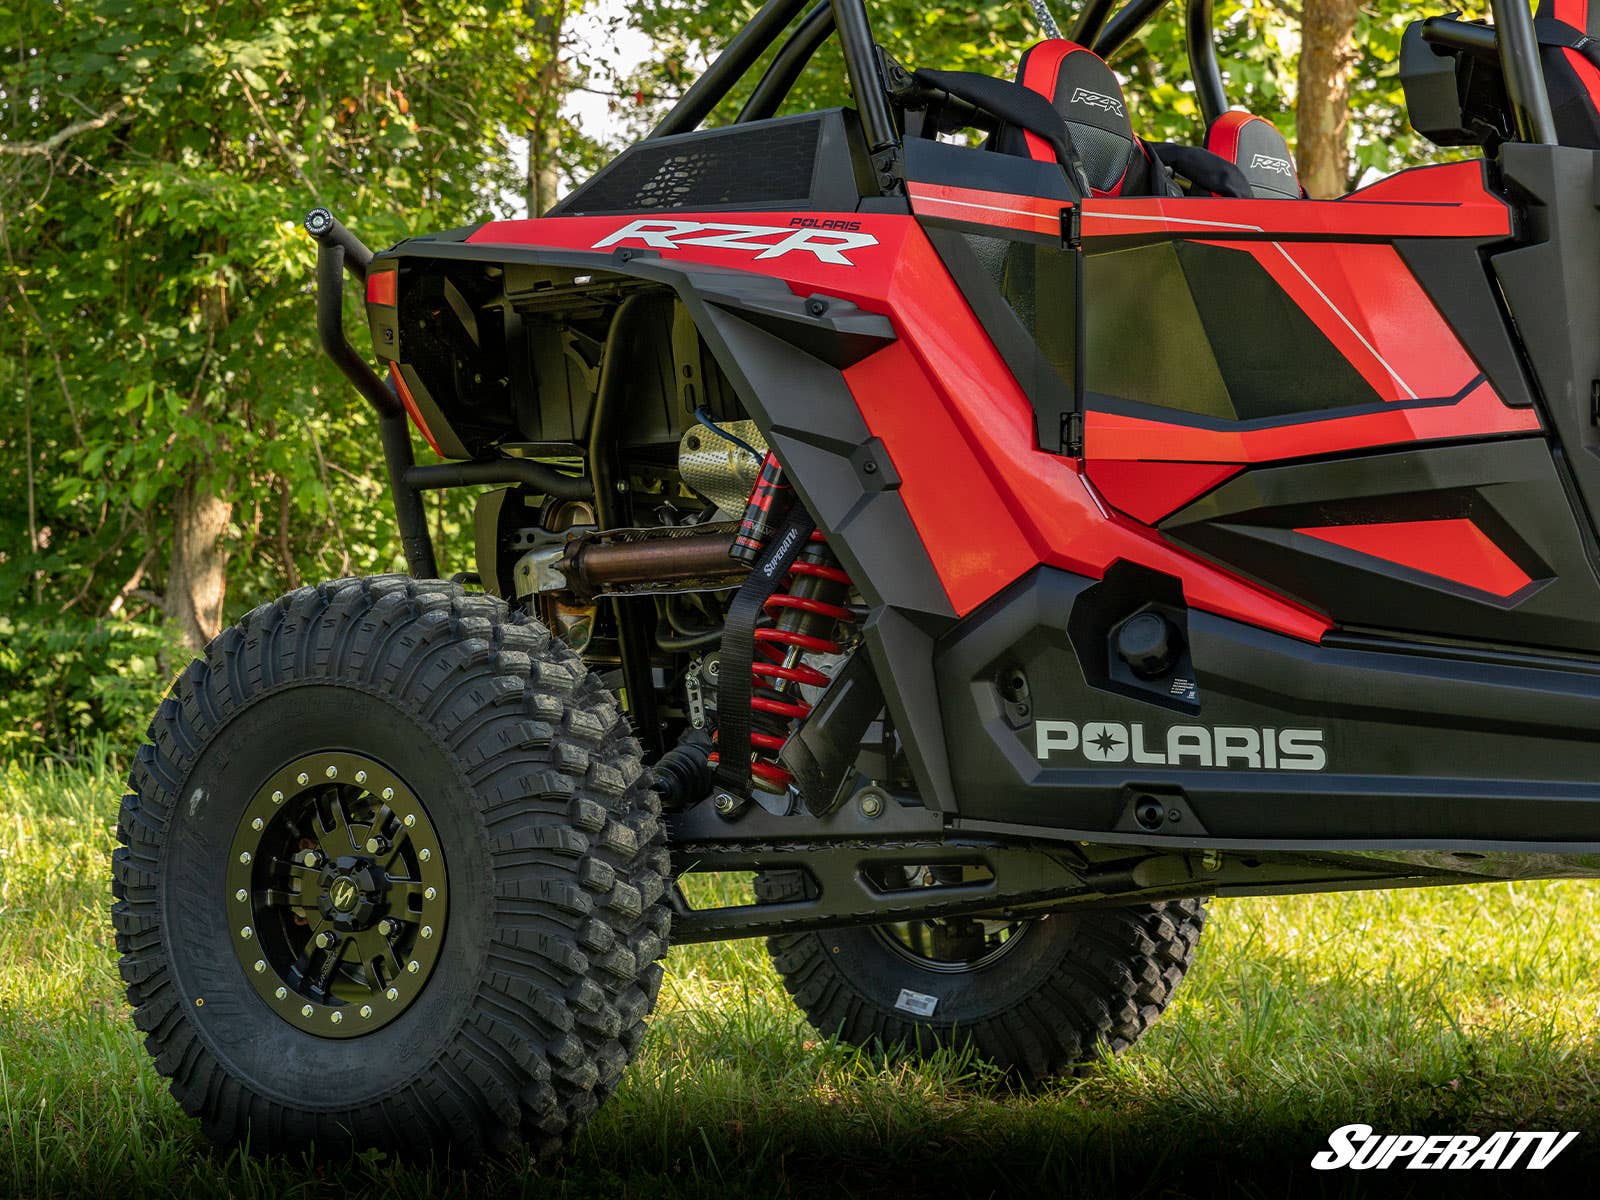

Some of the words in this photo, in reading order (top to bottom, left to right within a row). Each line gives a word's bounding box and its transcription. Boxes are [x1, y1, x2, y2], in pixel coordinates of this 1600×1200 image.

[1071, 88, 1124, 118] RZR
[1250, 153, 1292, 176] RZR
[790, 217, 862, 231] POLARIS
[591, 219, 880, 267] RZR
[1035, 720, 1327, 771] POLARIS
